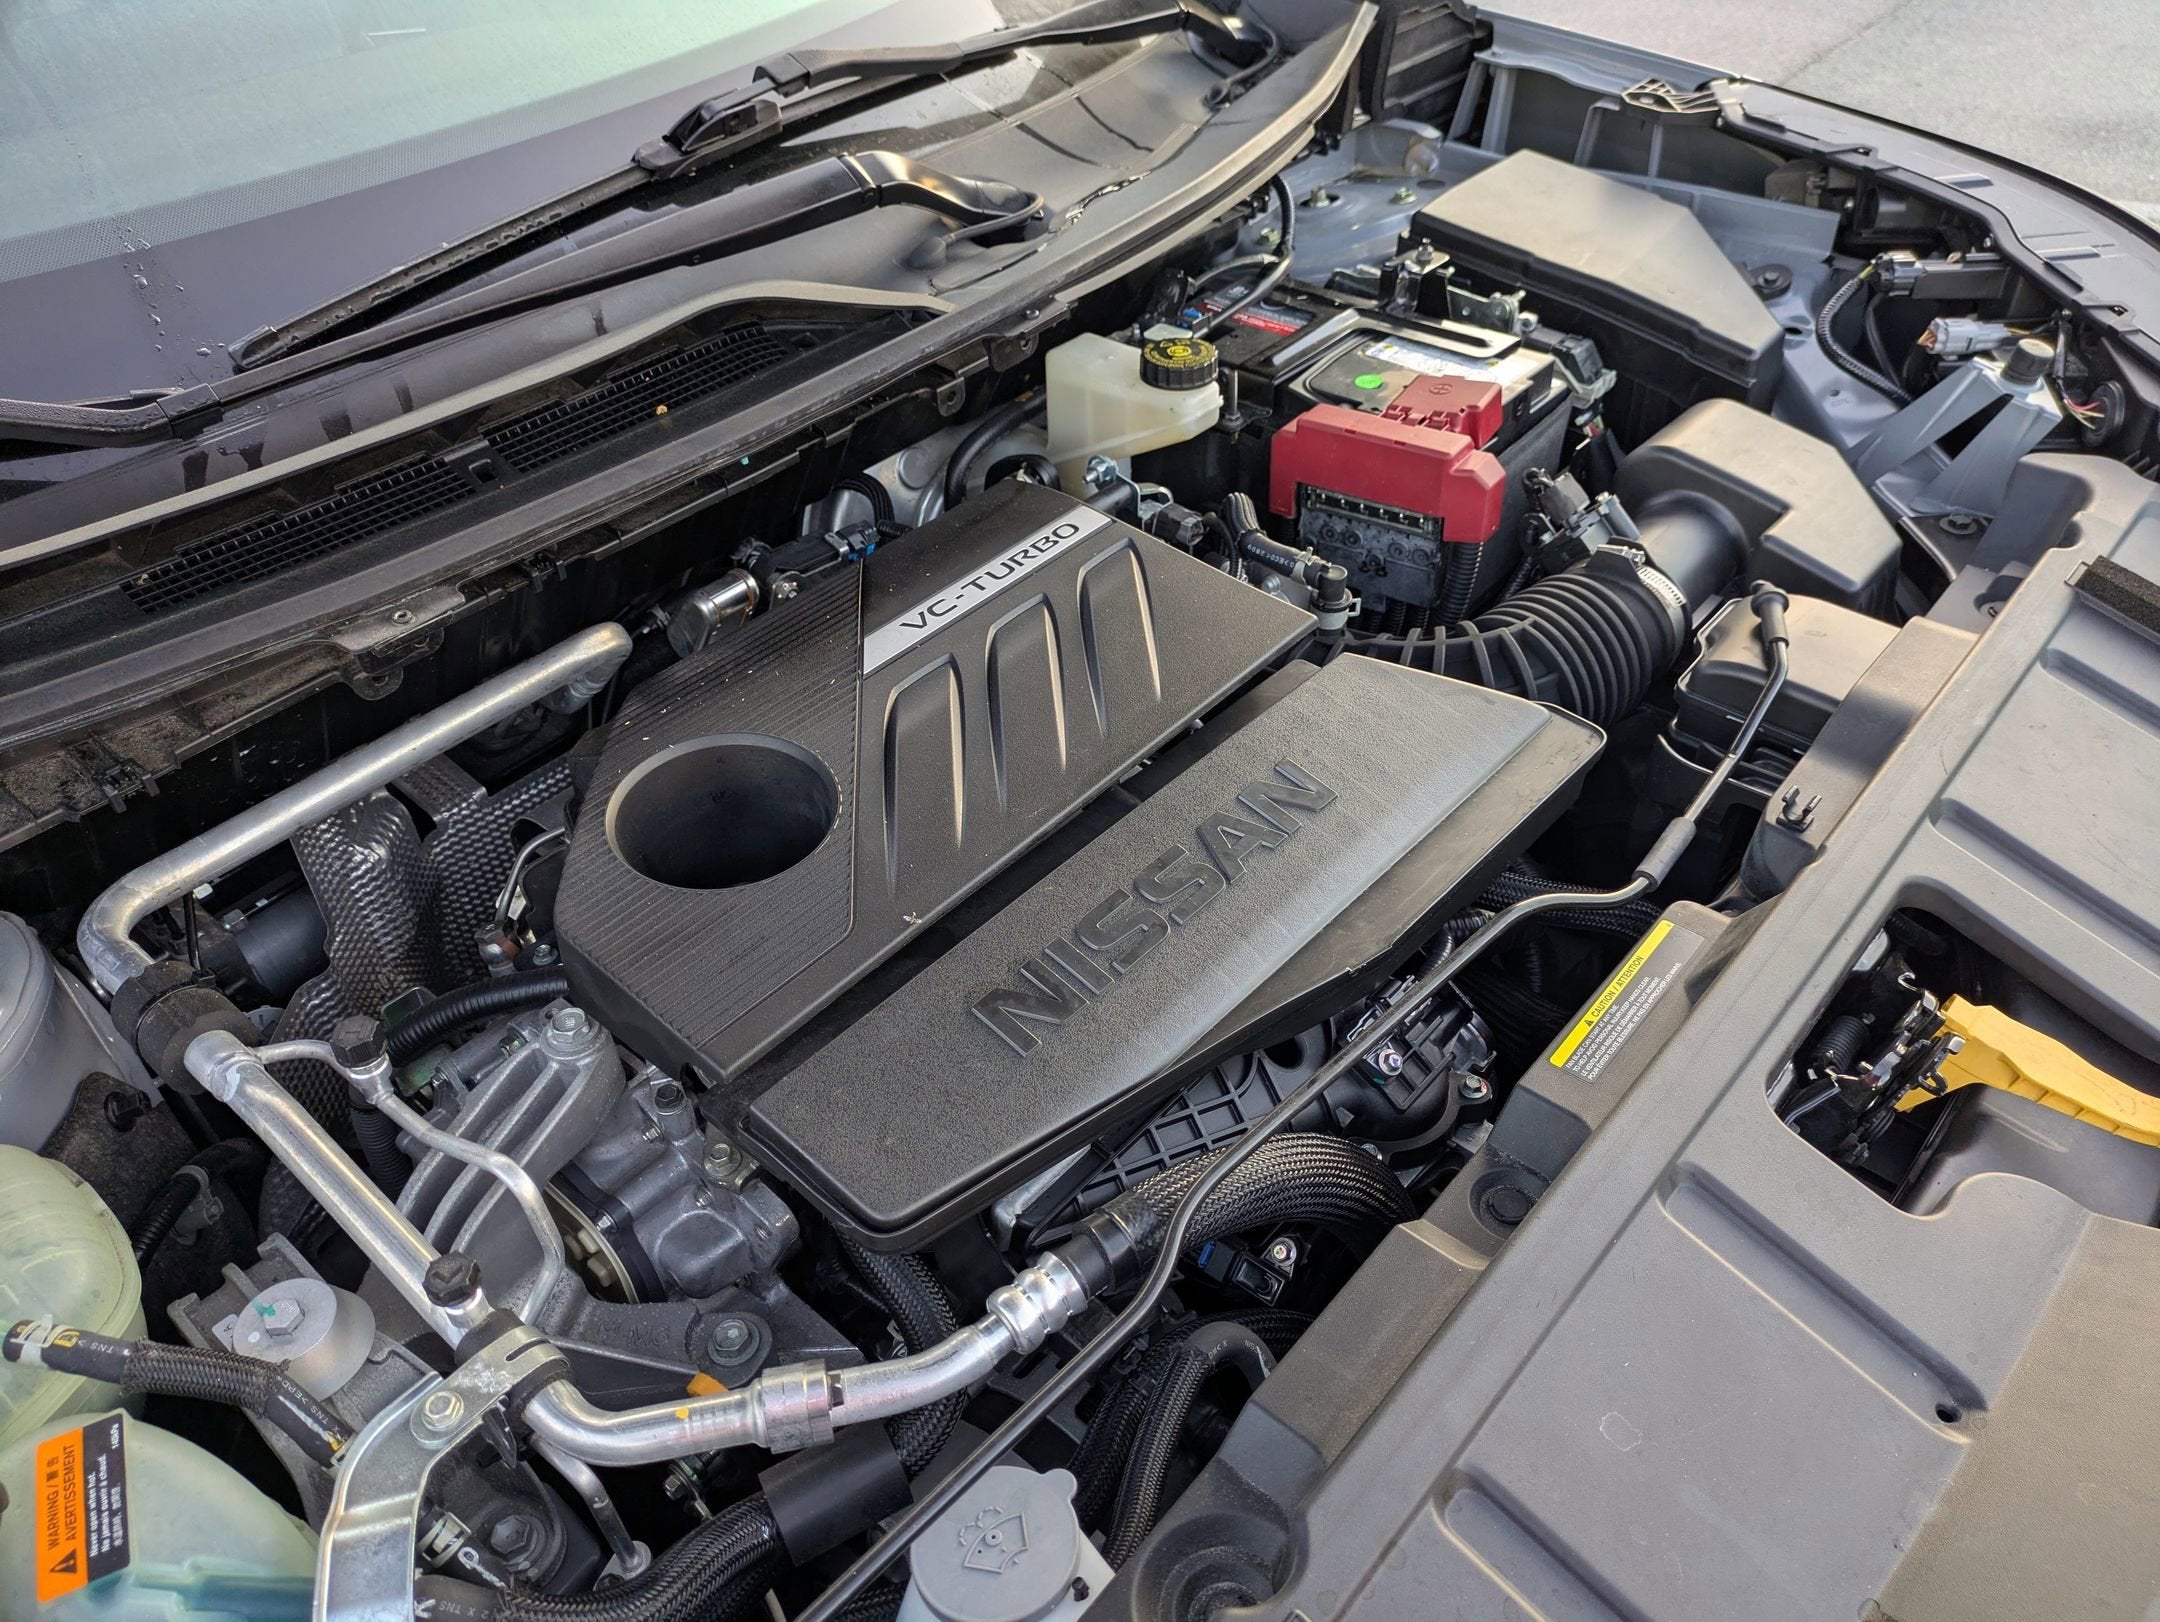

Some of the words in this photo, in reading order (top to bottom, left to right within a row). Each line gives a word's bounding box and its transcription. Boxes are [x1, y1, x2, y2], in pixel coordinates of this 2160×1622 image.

[899, 523, 1080, 629] VC-TURBO
[971, 757, 1338, 1058] NISSAN
[1589, 989, 1617, 1018] CAUTION
[1614, 954, 1645, 987] ATTENTION
[90, 1342, 114, 1354] TNS
[310, 1405, 329, 1425] TNS
[46, 1455, 59, 1482] 告
[63, 1442, 76, 1543] AVERTISSEMENT
[87, 1487, 96, 1510] when
[99, 1486, 108, 1511] ouvrir
[46, 1489, 60, 1551] WARNING
[88, 1509, 98, 1532] open
[100, 1509, 110, 1538] jamais
[89, 1530, 98, 1557] Never
[440, 1600, 461, 1614] TNS
